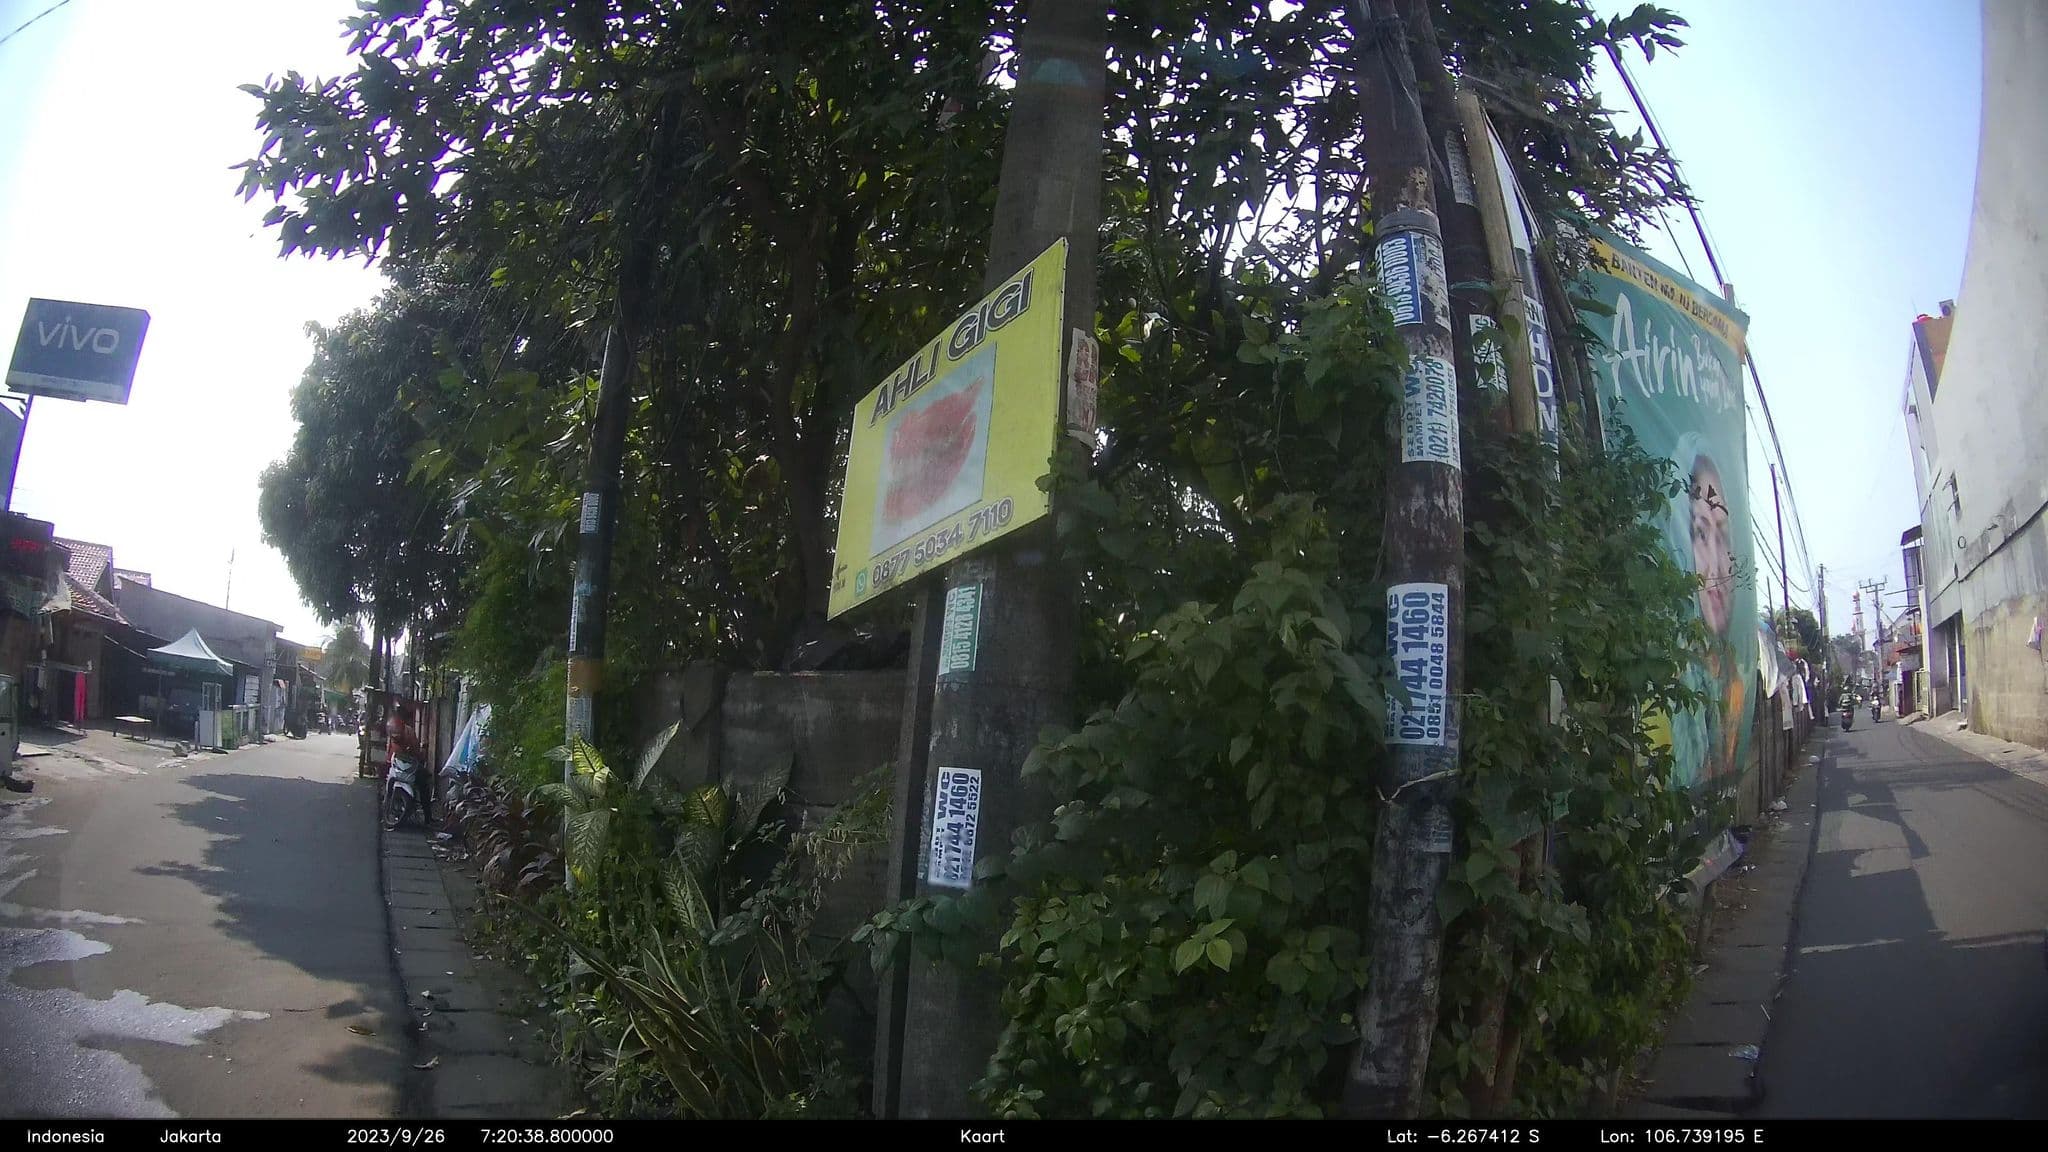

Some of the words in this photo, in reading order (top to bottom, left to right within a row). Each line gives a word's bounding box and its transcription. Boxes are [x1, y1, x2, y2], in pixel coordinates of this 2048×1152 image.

[1382, 238, 1409, 267] 0003
[38, 315, 120, 354] vivo
[868, 339, 942, 429] AHLI
[947, 267, 1034, 361] GIGI
[1602, 292, 1699, 404] Airin
[1414, 401, 1424, 457] MAMPET
[1427, 422, 1449, 459] (021)
[872, 548, 911, 589] 0877
[967, 497, 1014, 543] 7110
[1401, 592, 1430, 653] 1460
[1430, 593, 1445, 638] 5844
[951, 641, 971, 669] 0815
[1429, 643, 1444, 690] 0048
[937, 771, 951, 820] WC
[948, 773, 969, 818] 1460
[967, 776, 980, 811] 5522
